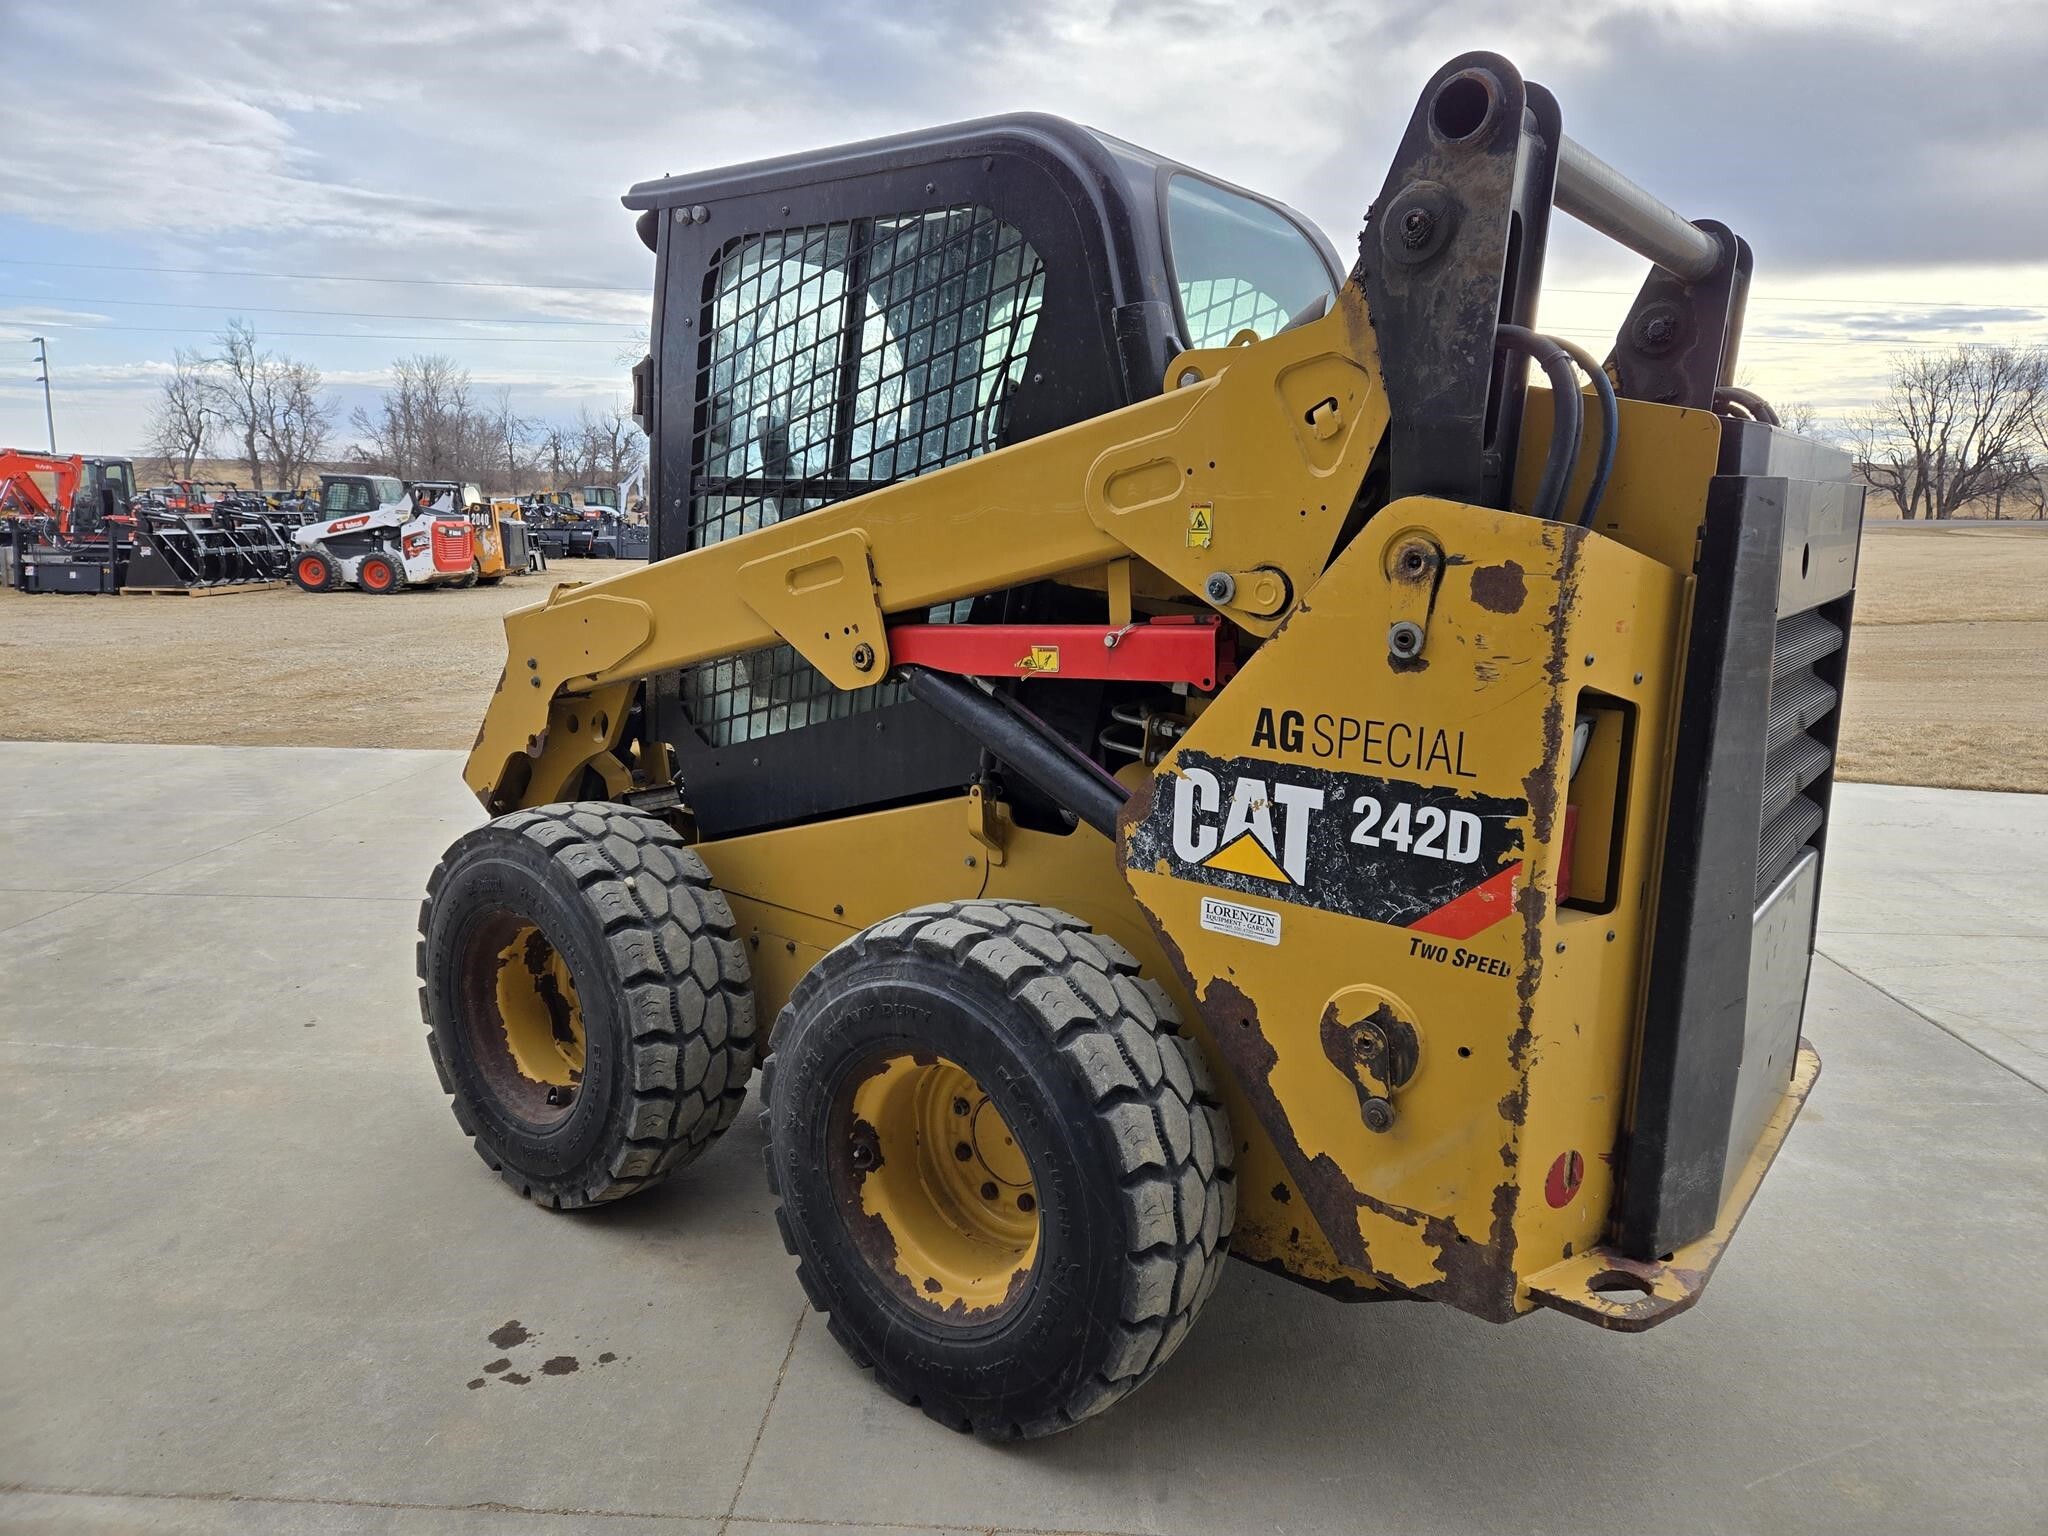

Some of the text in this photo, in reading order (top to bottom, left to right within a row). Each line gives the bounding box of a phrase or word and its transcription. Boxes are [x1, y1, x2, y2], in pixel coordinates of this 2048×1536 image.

[471, 513, 489, 526] 2040
[1251, 707, 1477, 778] AG SPECIAL
[1172, 767, 1482, 887] CAT 242D
[1205, 903, 1275, 928] LORENZEN
[1206, 914, 1242, 927] EQUIPMENT
